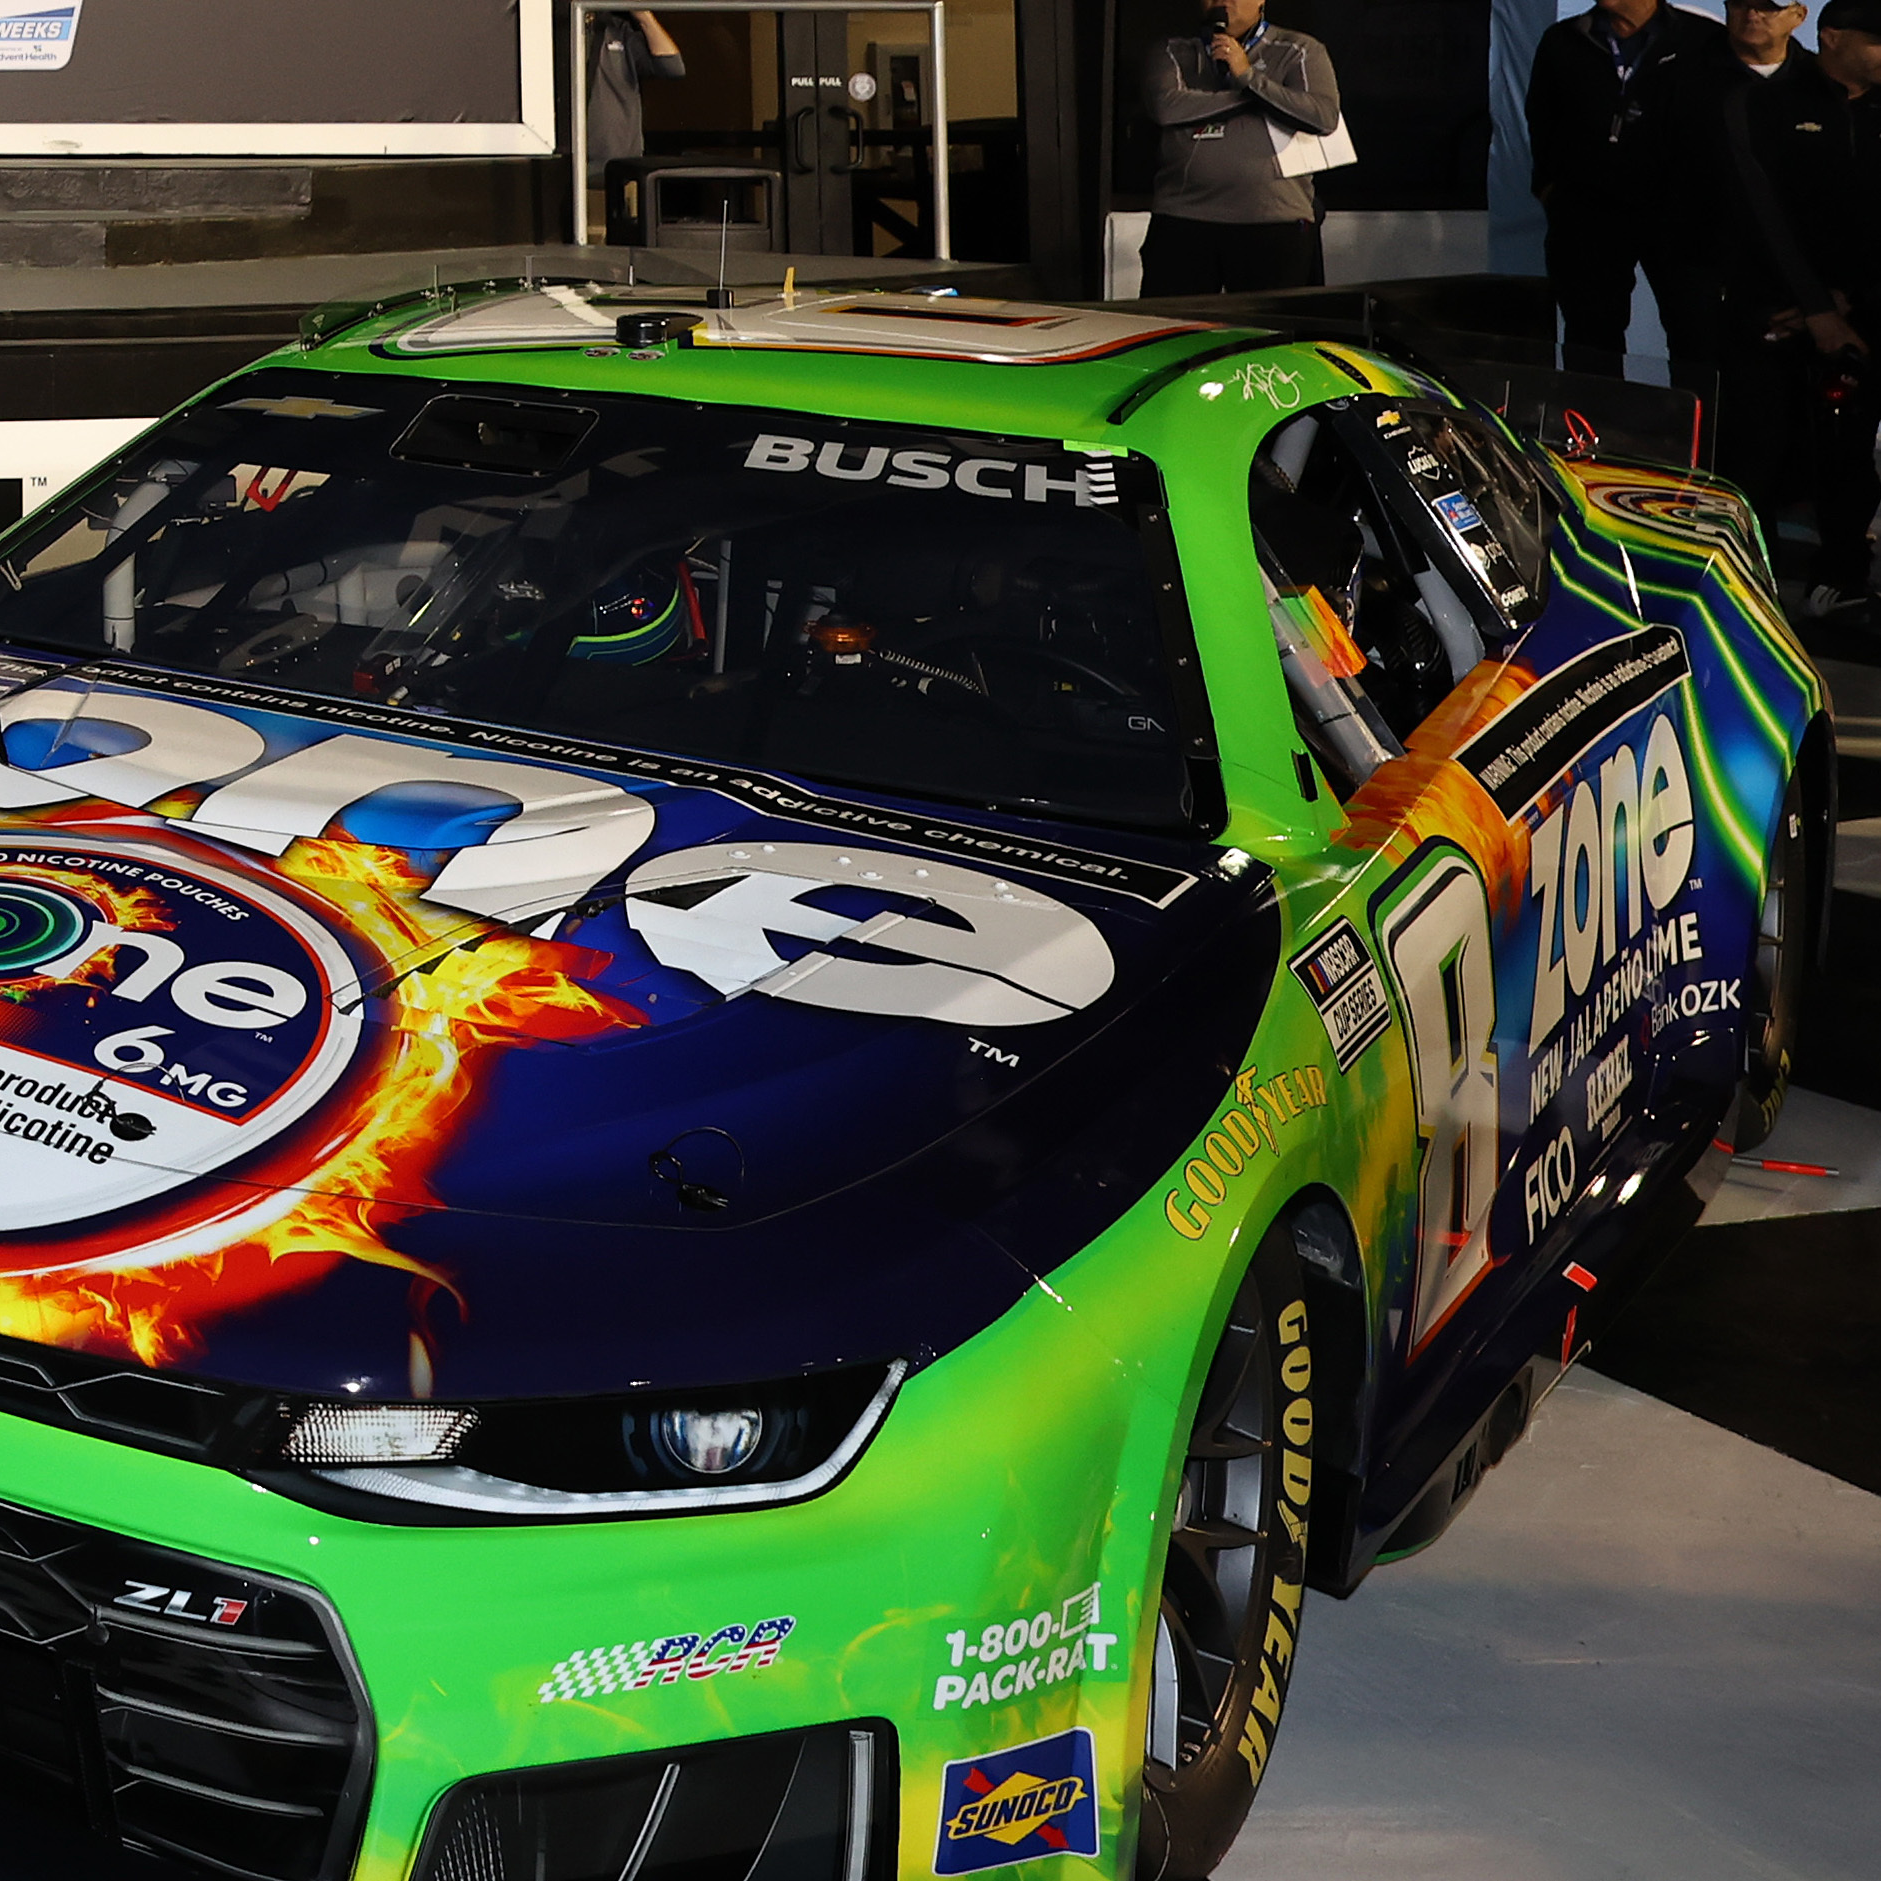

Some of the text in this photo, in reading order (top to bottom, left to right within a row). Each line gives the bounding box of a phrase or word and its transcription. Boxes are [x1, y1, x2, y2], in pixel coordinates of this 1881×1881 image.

[791, 77, 842, 87] PULL PULL
[743, 434, 1097, 506] BUSCH
[173, 675, 309, 710] contains
[316, 701, 455, 735] nicotine.
[470, 730, 617, 762] Nicotine
[629, 758, 659, 770] is
[669, 767, 718, 781] an
[730, 775, 915, 833] addictive
[923, 826, 1130, 881] chemical.
[16, 853, 141, 883] NICOTINE
[143, 872, 250, 921] POUCHES
[1529, 714, 1694, 1057] zone
[1318, 933, 1360, 987] NASCAR
[1333, 977, 1378, 1041] CUP SERIES
[1529, 913, 1703, 1125] NEW JALAPEÑO LIME
[1651, 978, 1741, 1038] Bank OZK
[94, 1025, 247, 1109] 6 MG
[1586, 1034, 1634, 1132] REBEL
[1165, 1064, 1328, 1240] GOODYEAR
[1524, 1125, 1576, 1246] FICO
[1238, 1298, 1313, 1789] GOODYEAR
[113, 1580, 248, 1626] ZL1
[946, 1610, 1062, 1669] 1-800-
[635, 1616, 797, 1689] RCR
[933, 1632, 1118, 1710] PACK-RAT
[954, 1780, 1081, 1838] SUNOCO
